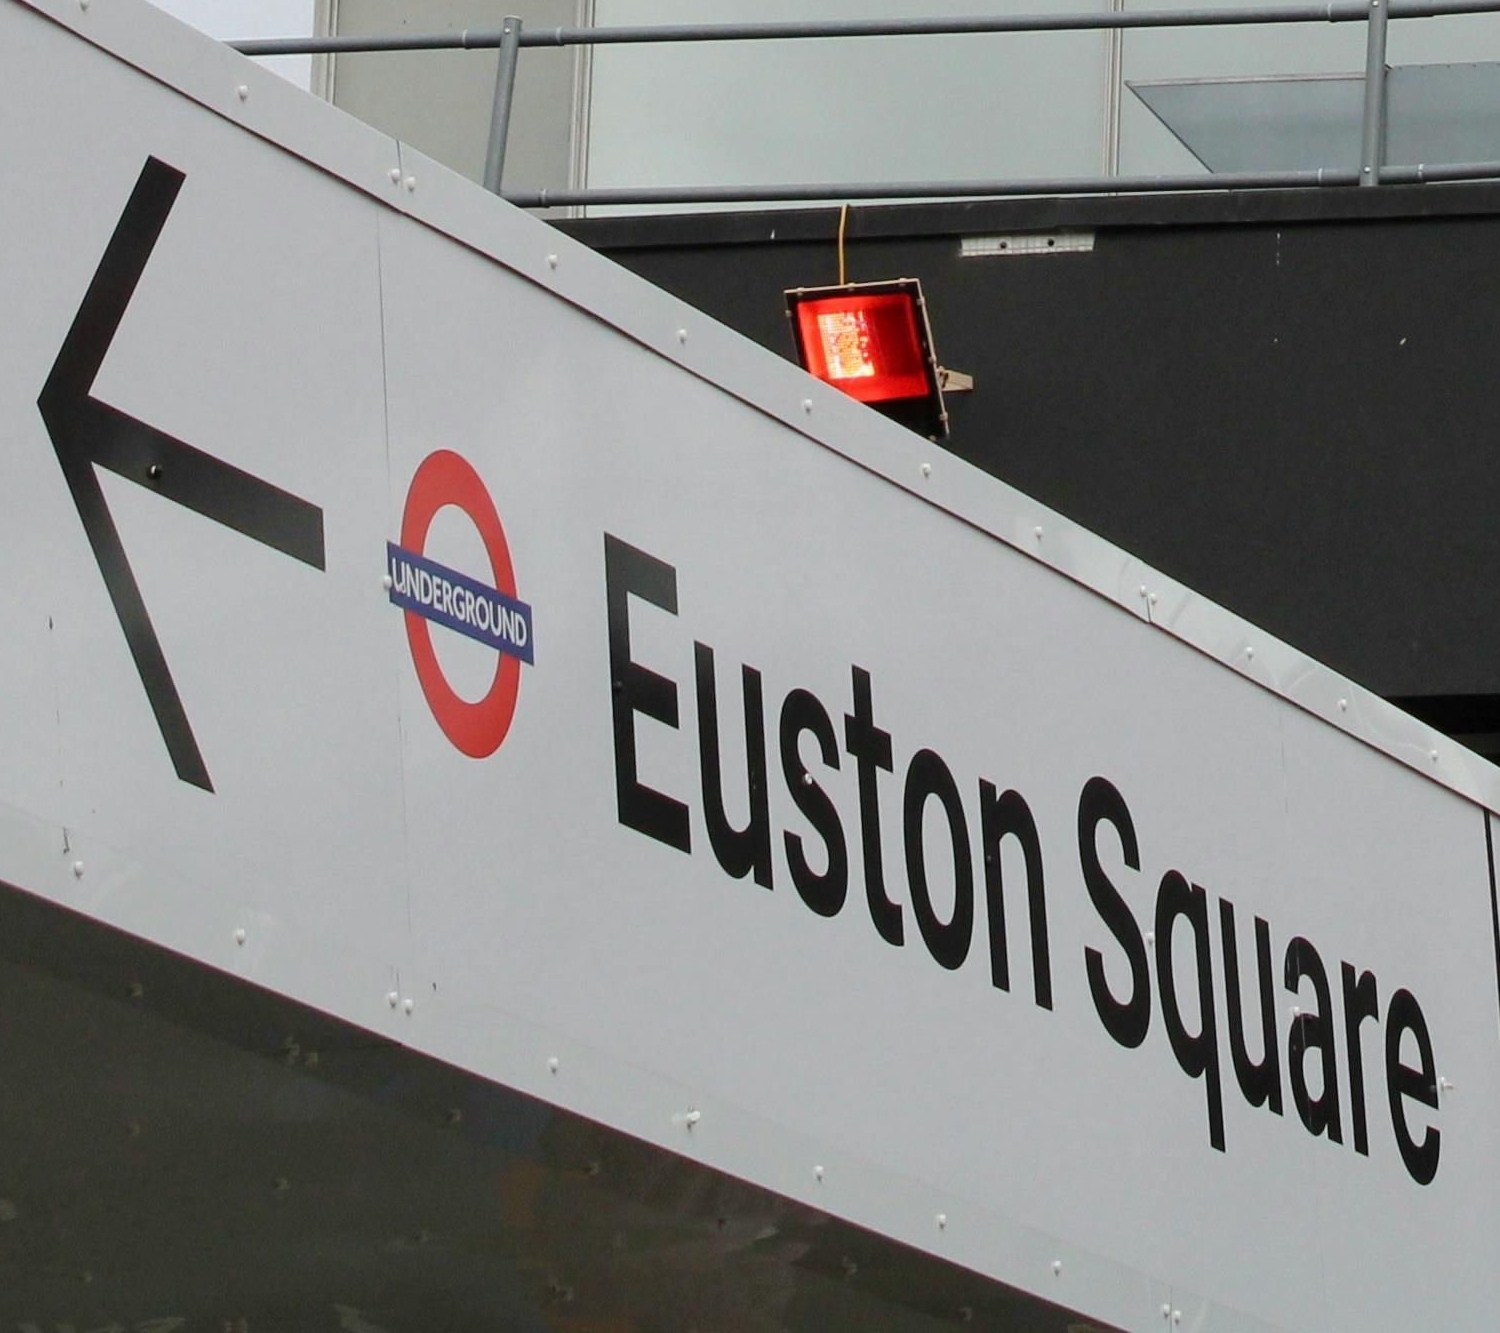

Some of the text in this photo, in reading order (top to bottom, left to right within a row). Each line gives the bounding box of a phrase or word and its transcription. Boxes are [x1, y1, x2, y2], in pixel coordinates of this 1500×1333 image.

[391, 557, 528, 648] UNDERGROUND
[603, 531, 1441, 1187] Euston Square
